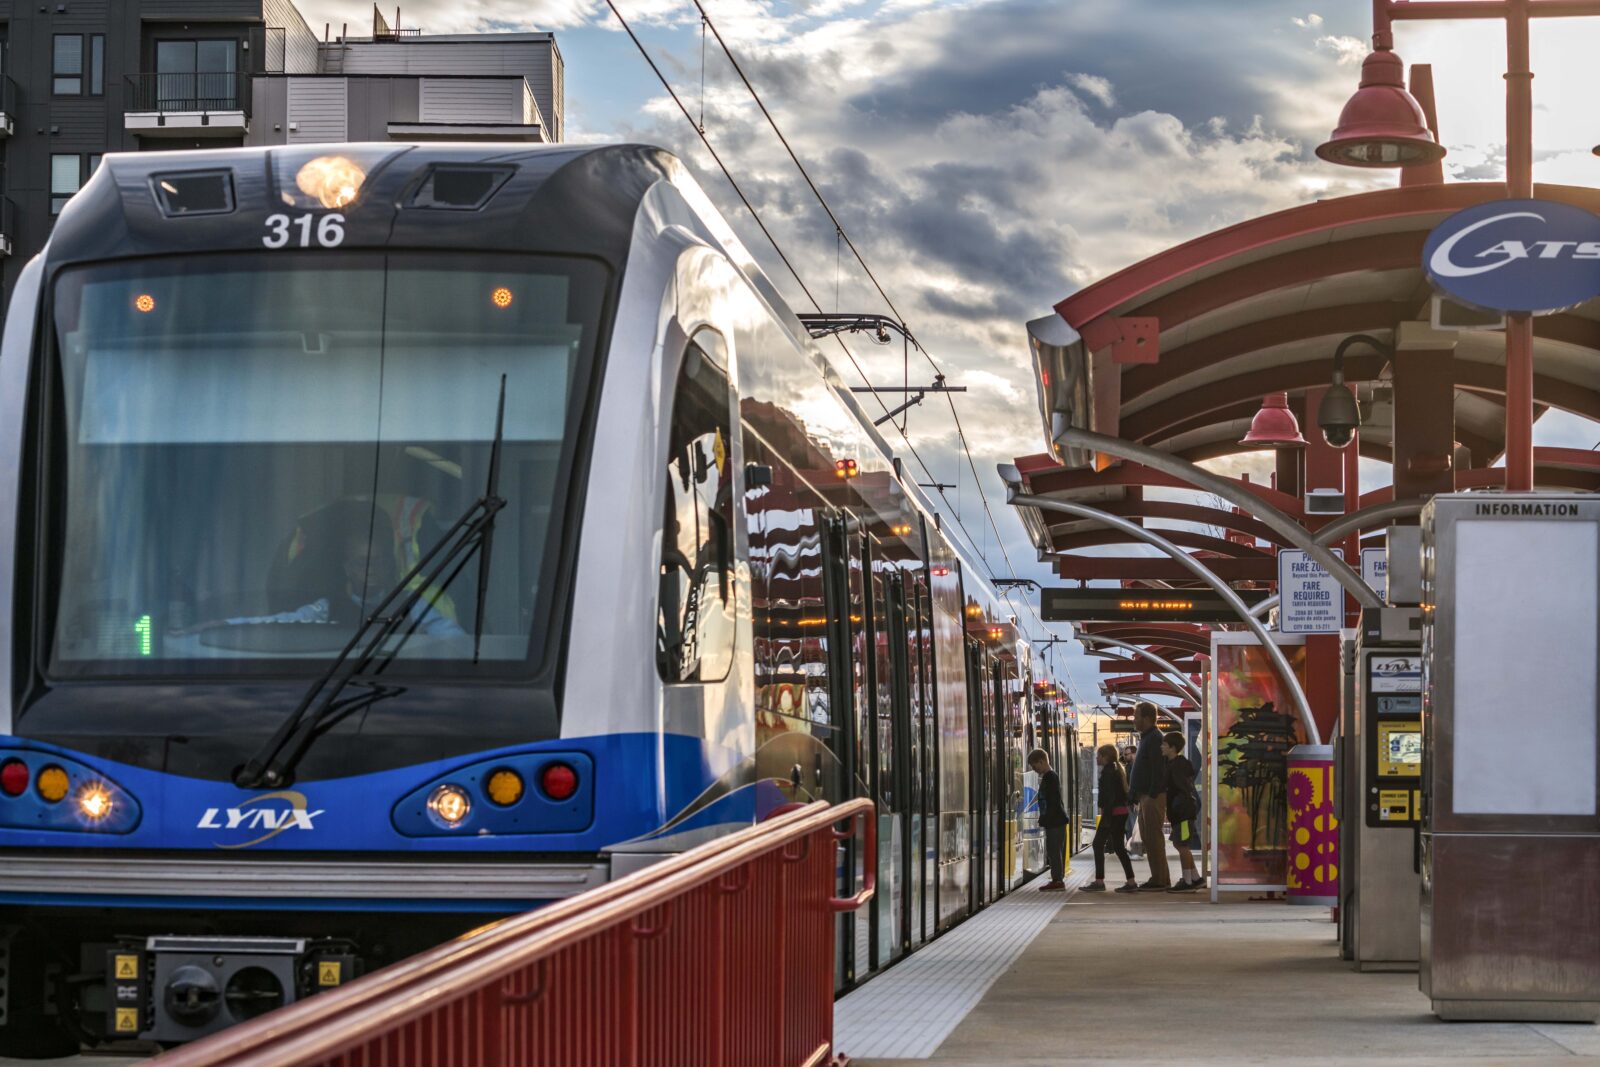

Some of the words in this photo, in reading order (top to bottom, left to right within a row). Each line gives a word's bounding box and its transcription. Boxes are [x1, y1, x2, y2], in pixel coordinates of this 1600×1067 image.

[262, 213, 345, 248] 316
[1430, 212, 1600, 277] CATS
[1476, 504, 1578, 515] INFORMATION
[1291, 563, 1309, 571] FARE
[1374, 561, 1386, 571] FAR
[1302, 582, 1321, 590] FARE
[1293, 591, 1330, 600] REQUIRED
[135, 615, 150, 655] 1
[1376, 663, 1414, 671] LYNX
[197, 808, 325, 830] LYNX
